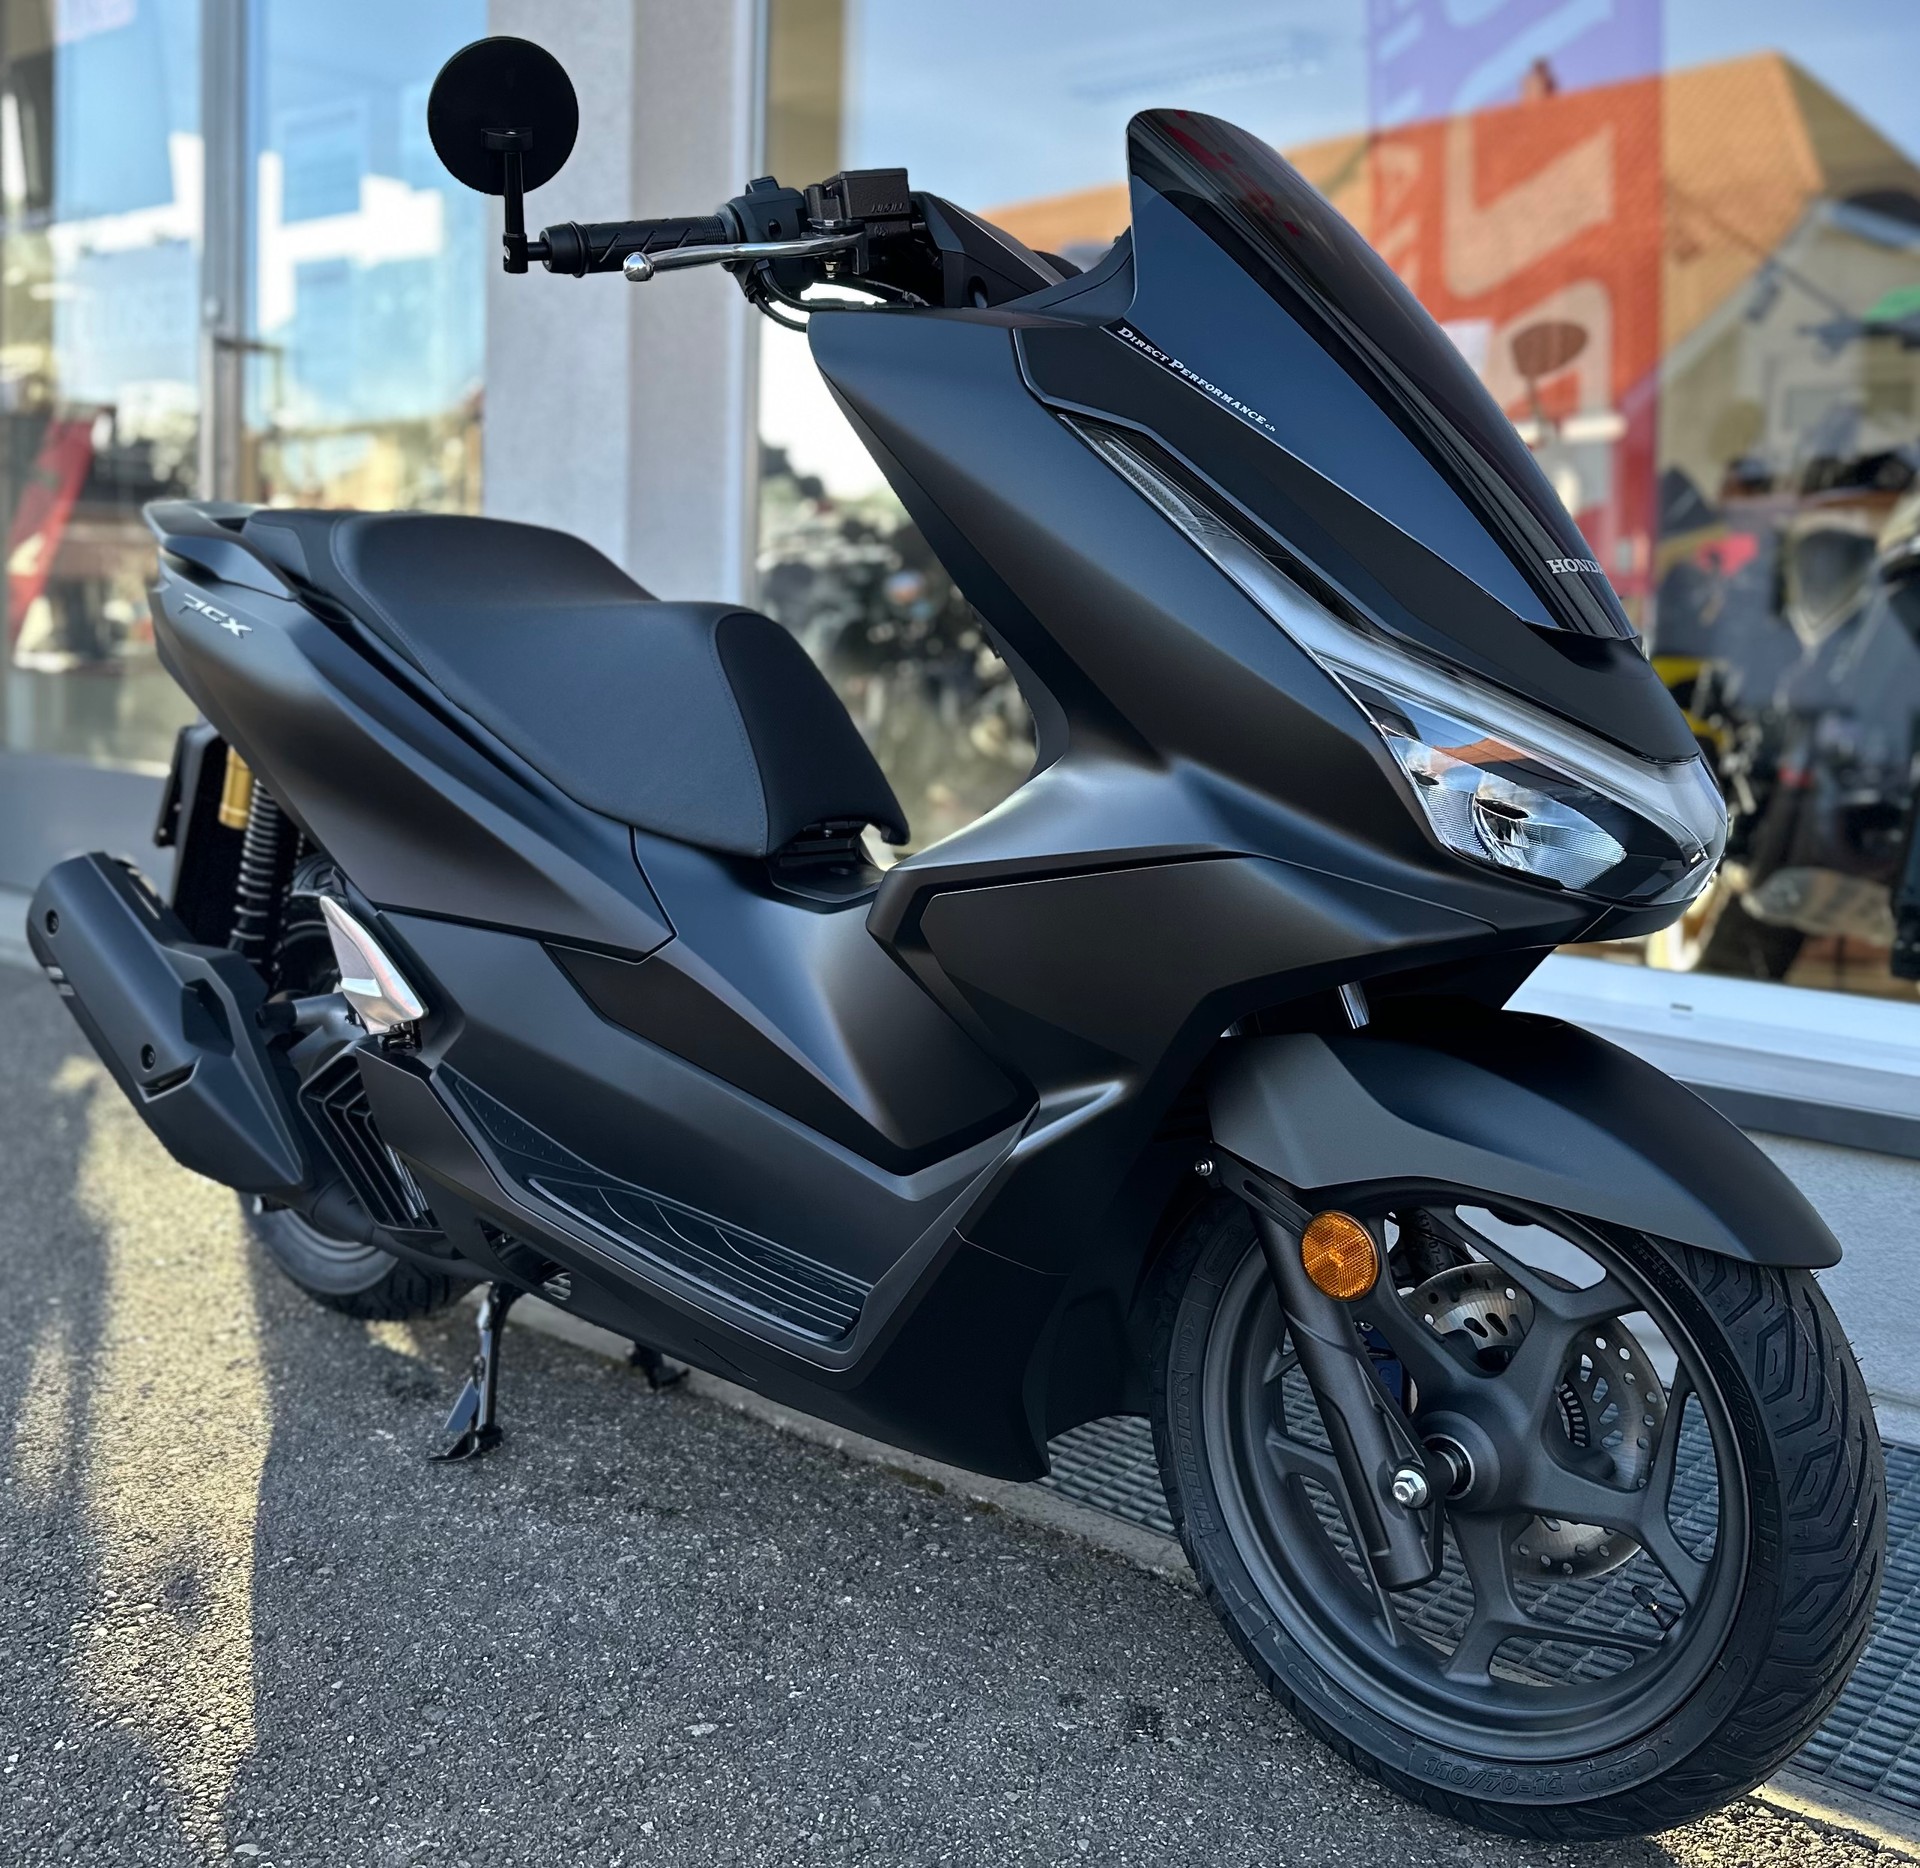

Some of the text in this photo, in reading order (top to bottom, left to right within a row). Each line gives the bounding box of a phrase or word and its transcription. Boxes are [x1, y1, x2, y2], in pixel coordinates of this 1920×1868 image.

[1117, 326, 1170, 362] DIRECT
[177, 592, 254, 639] PCX
[1176, 1402, 1217, 1531] MICHELIN
[1424, 1755, 1566, 1797] 110/70-14
